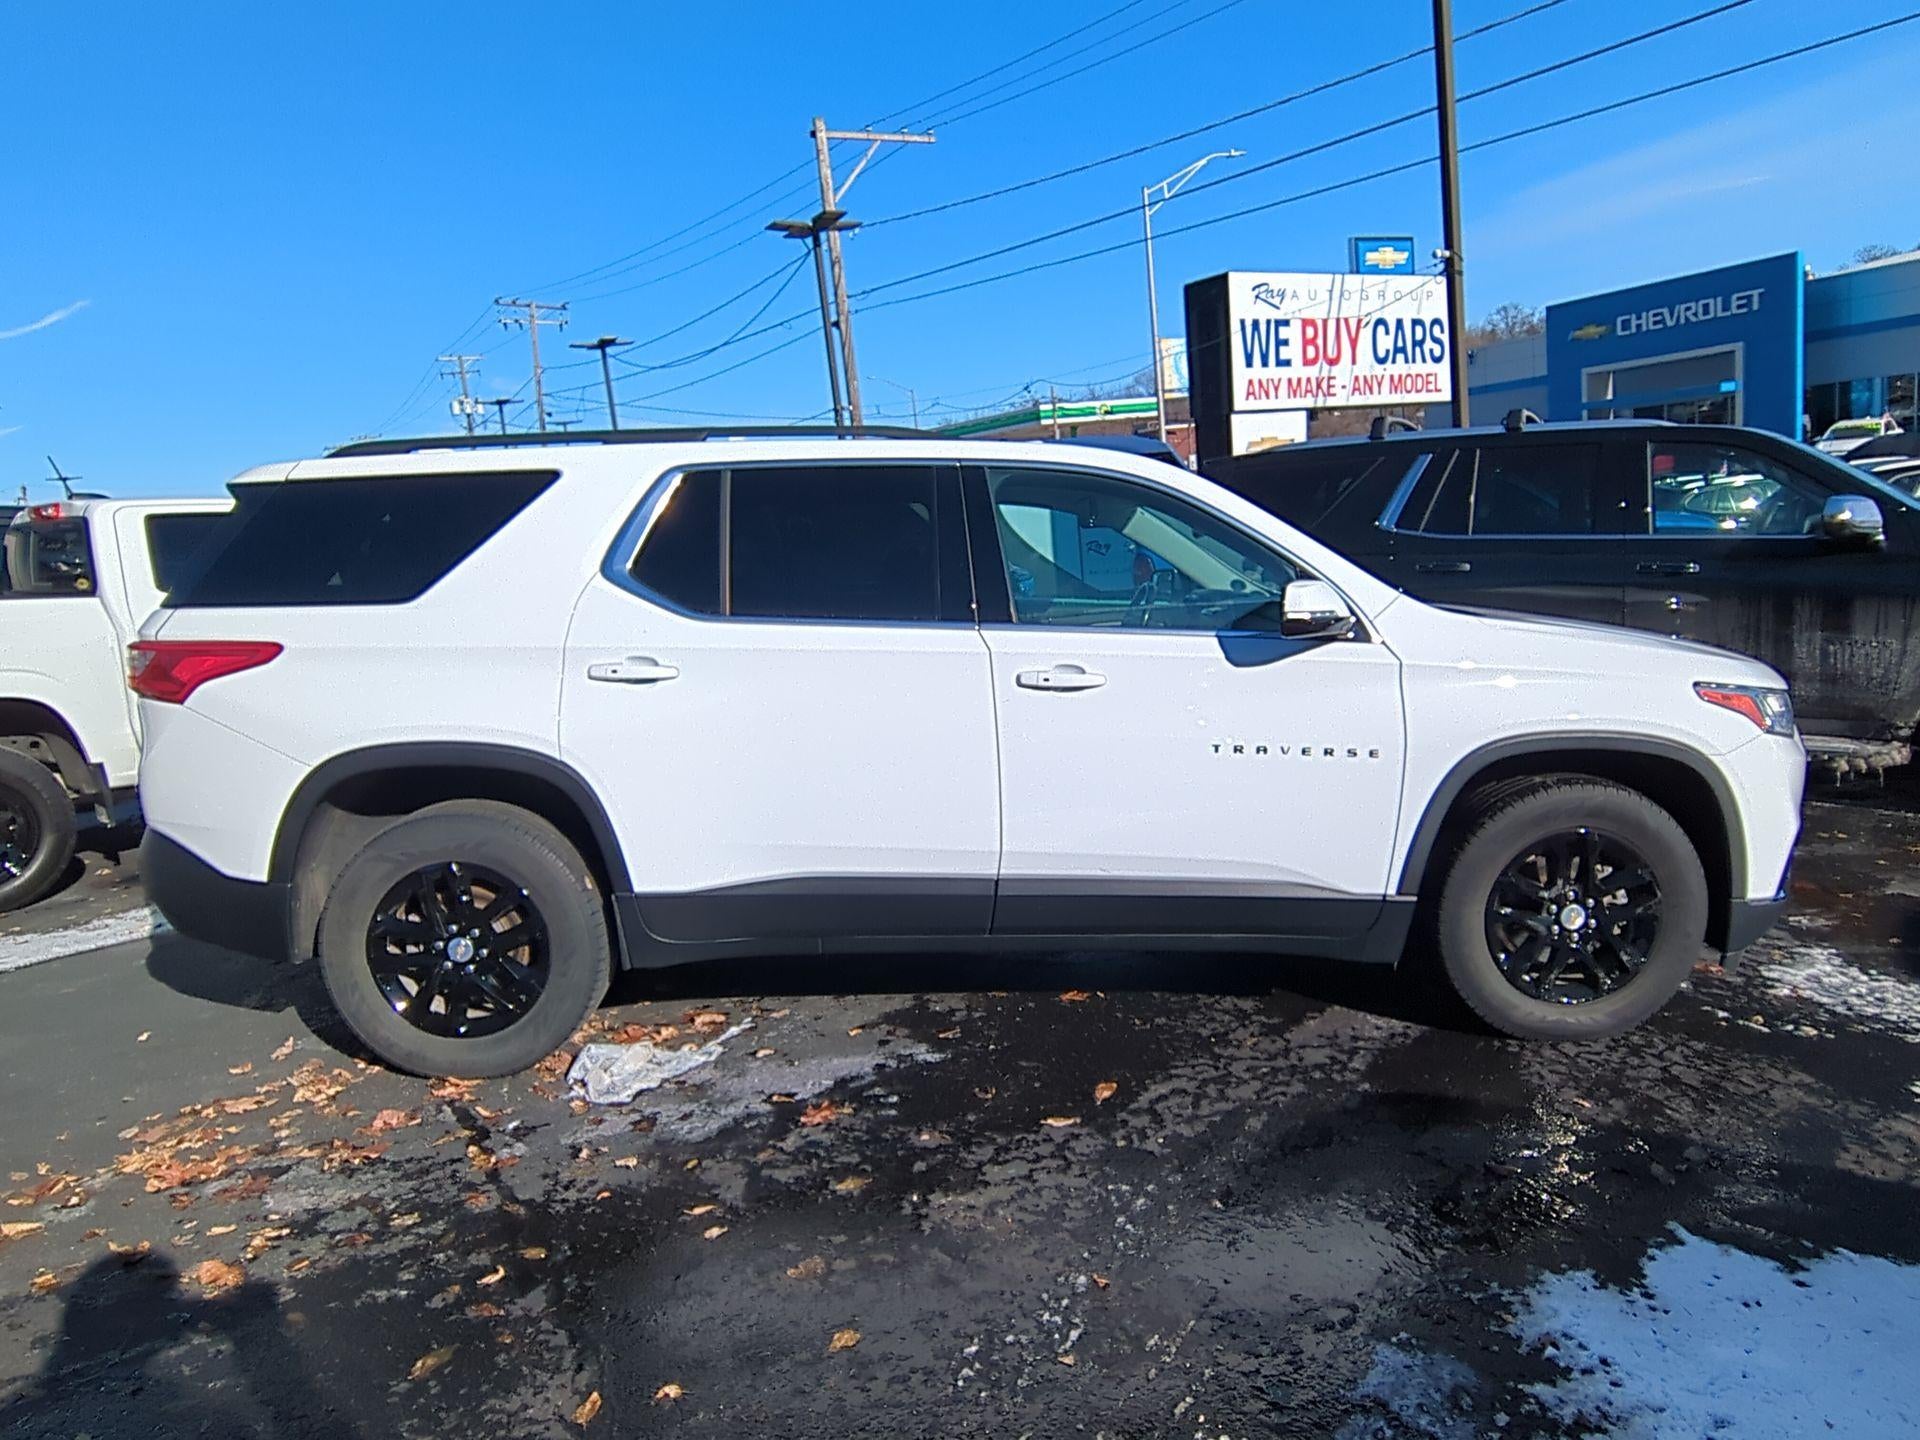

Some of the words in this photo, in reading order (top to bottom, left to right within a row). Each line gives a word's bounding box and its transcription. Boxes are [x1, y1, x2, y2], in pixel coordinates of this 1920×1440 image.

[1251, 282, 1286, 310] Ray
[1616, 288, 1765, 336] CHEVROLET
[1239, 318, 1292, 368] WE
[1301, 317, 1363, 367] BUY
[1371, 317, 1445, 365] CARS
[1245, 378, 1281, 400] ANY
[1287, 376, 1336, 399] MAKE
[1351, 374, 1385, 396] ANY
[1389, 373, 1442, 395] MODEL
[1211, 744, 1380, 759] TRAVERSE
